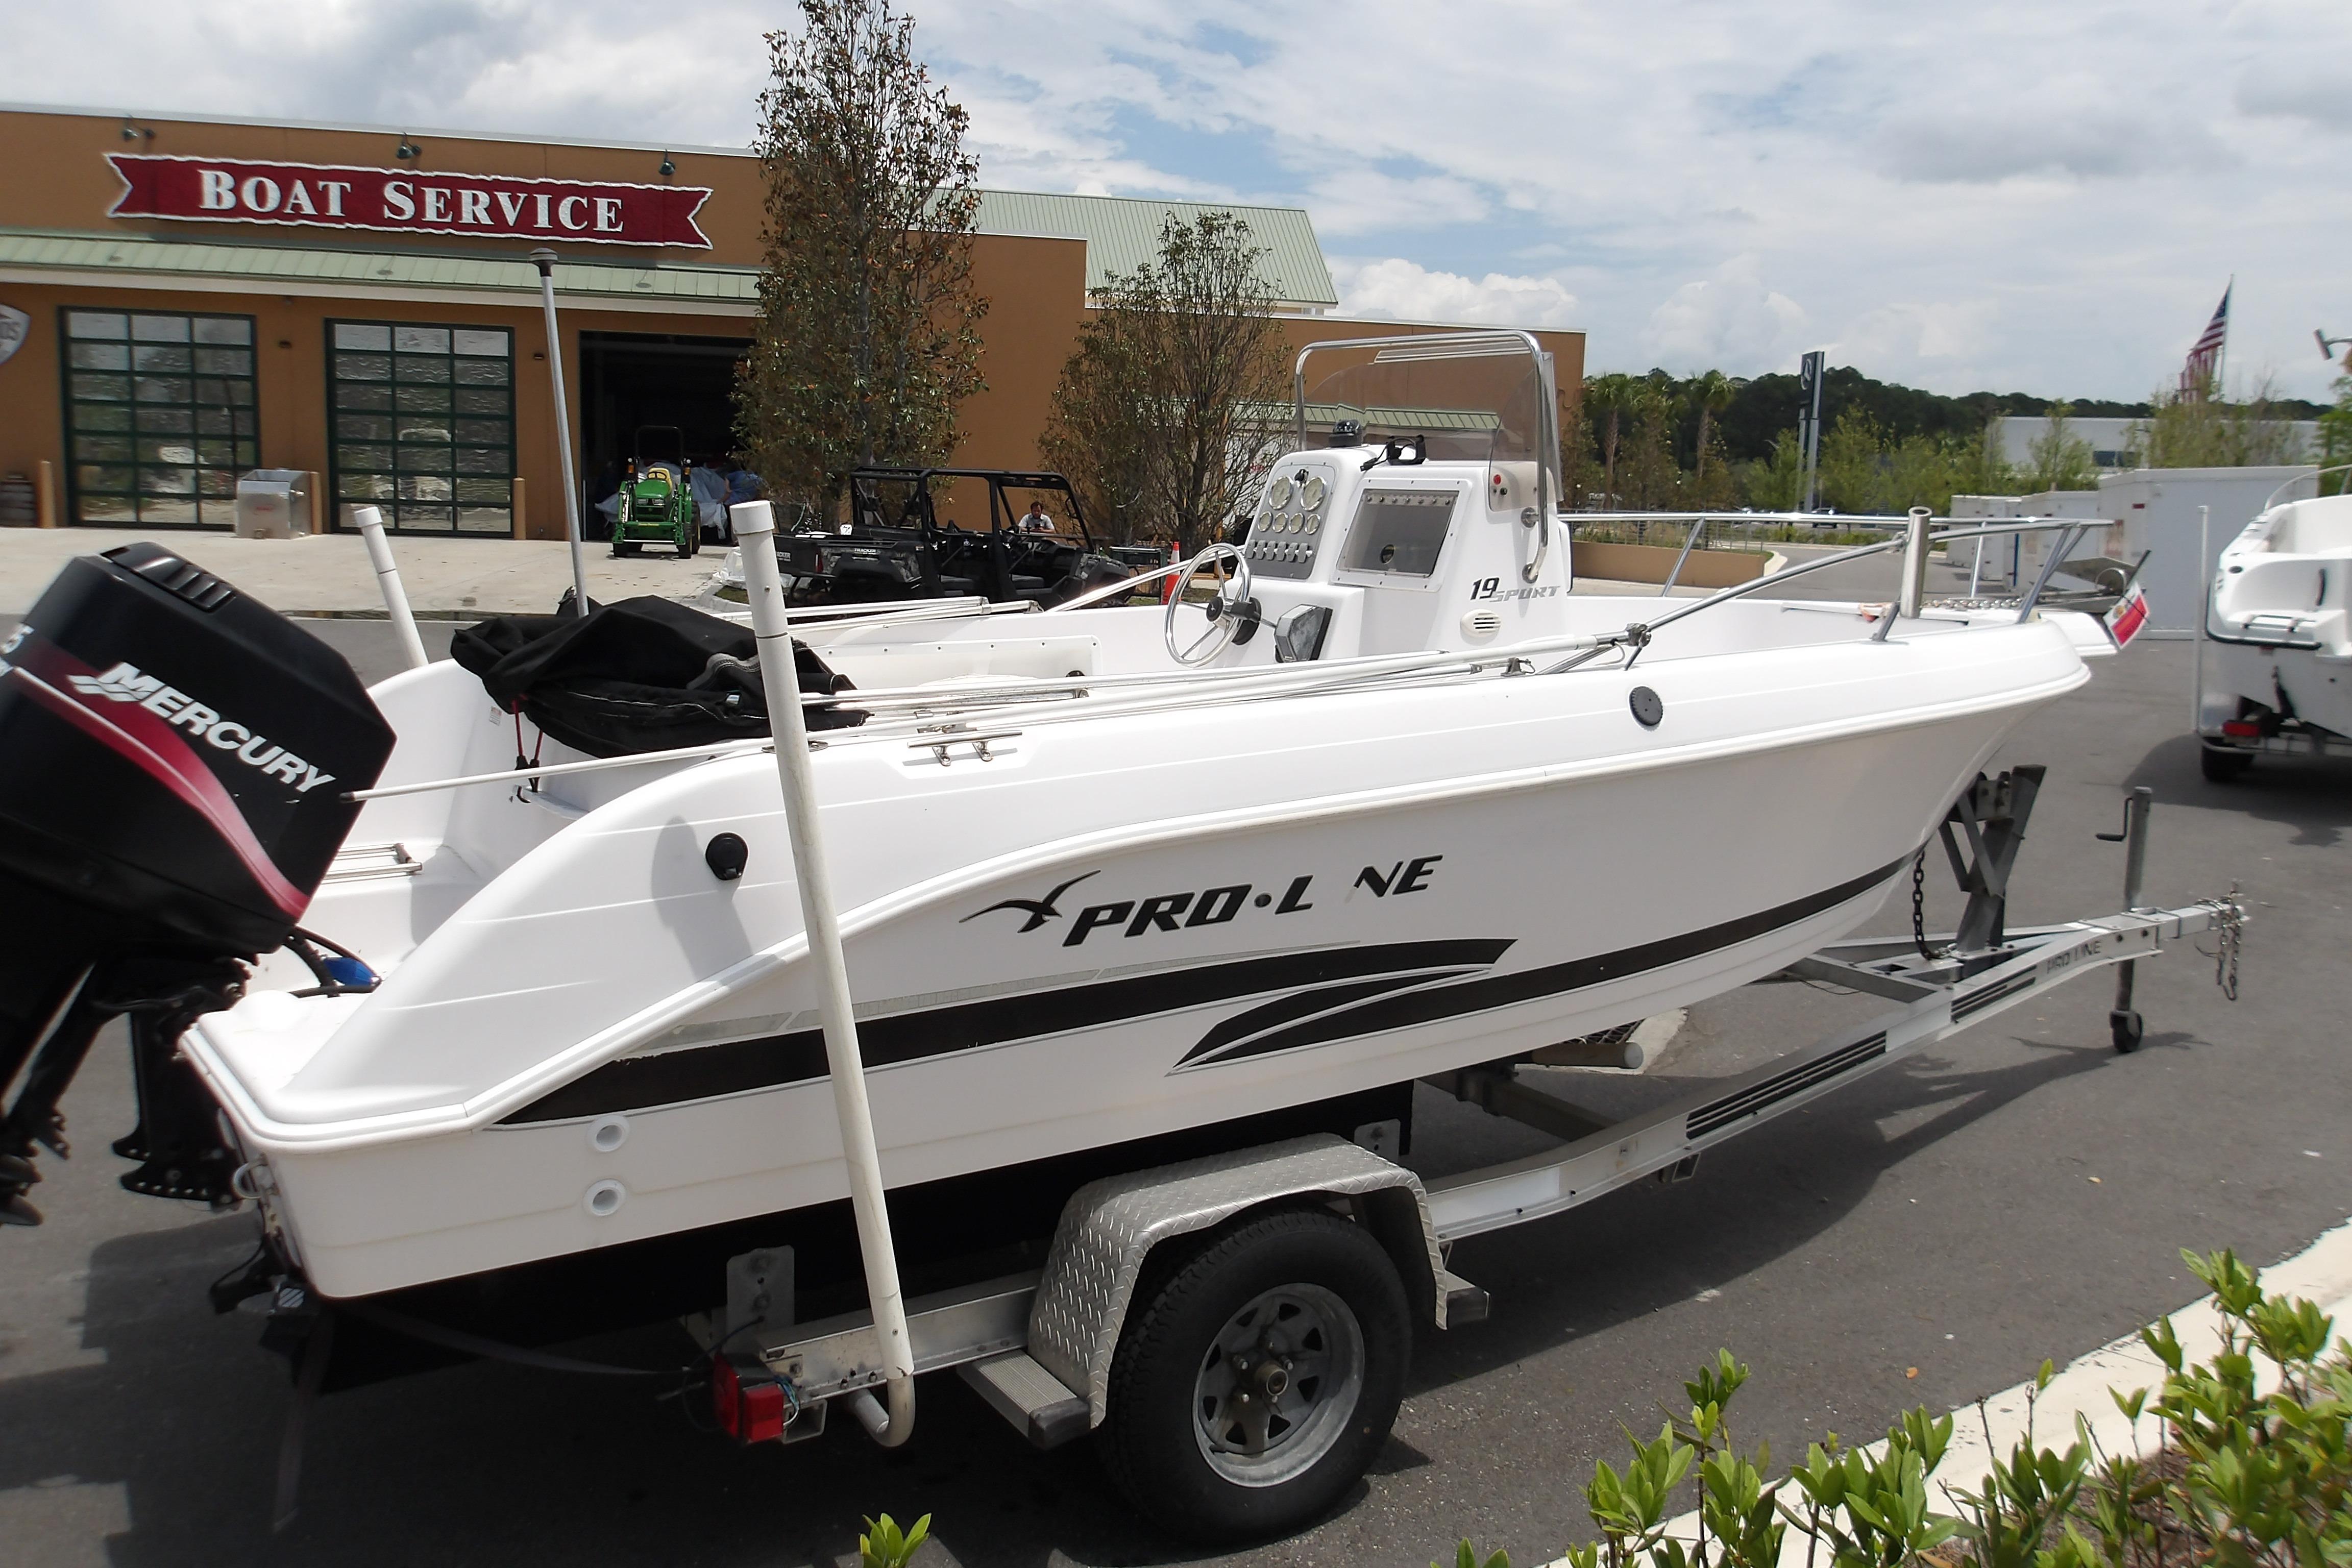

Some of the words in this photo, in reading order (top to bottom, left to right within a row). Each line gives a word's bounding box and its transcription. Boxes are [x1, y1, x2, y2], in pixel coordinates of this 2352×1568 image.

[197, 169, 352, 216] BOAT
[383, 181, 624, 232] SERVICE
[1470, 577, 1500, 600] 19
[1489, 585, 1561, 602] SPORT
[96, 662, 336, 793] MERCURY
